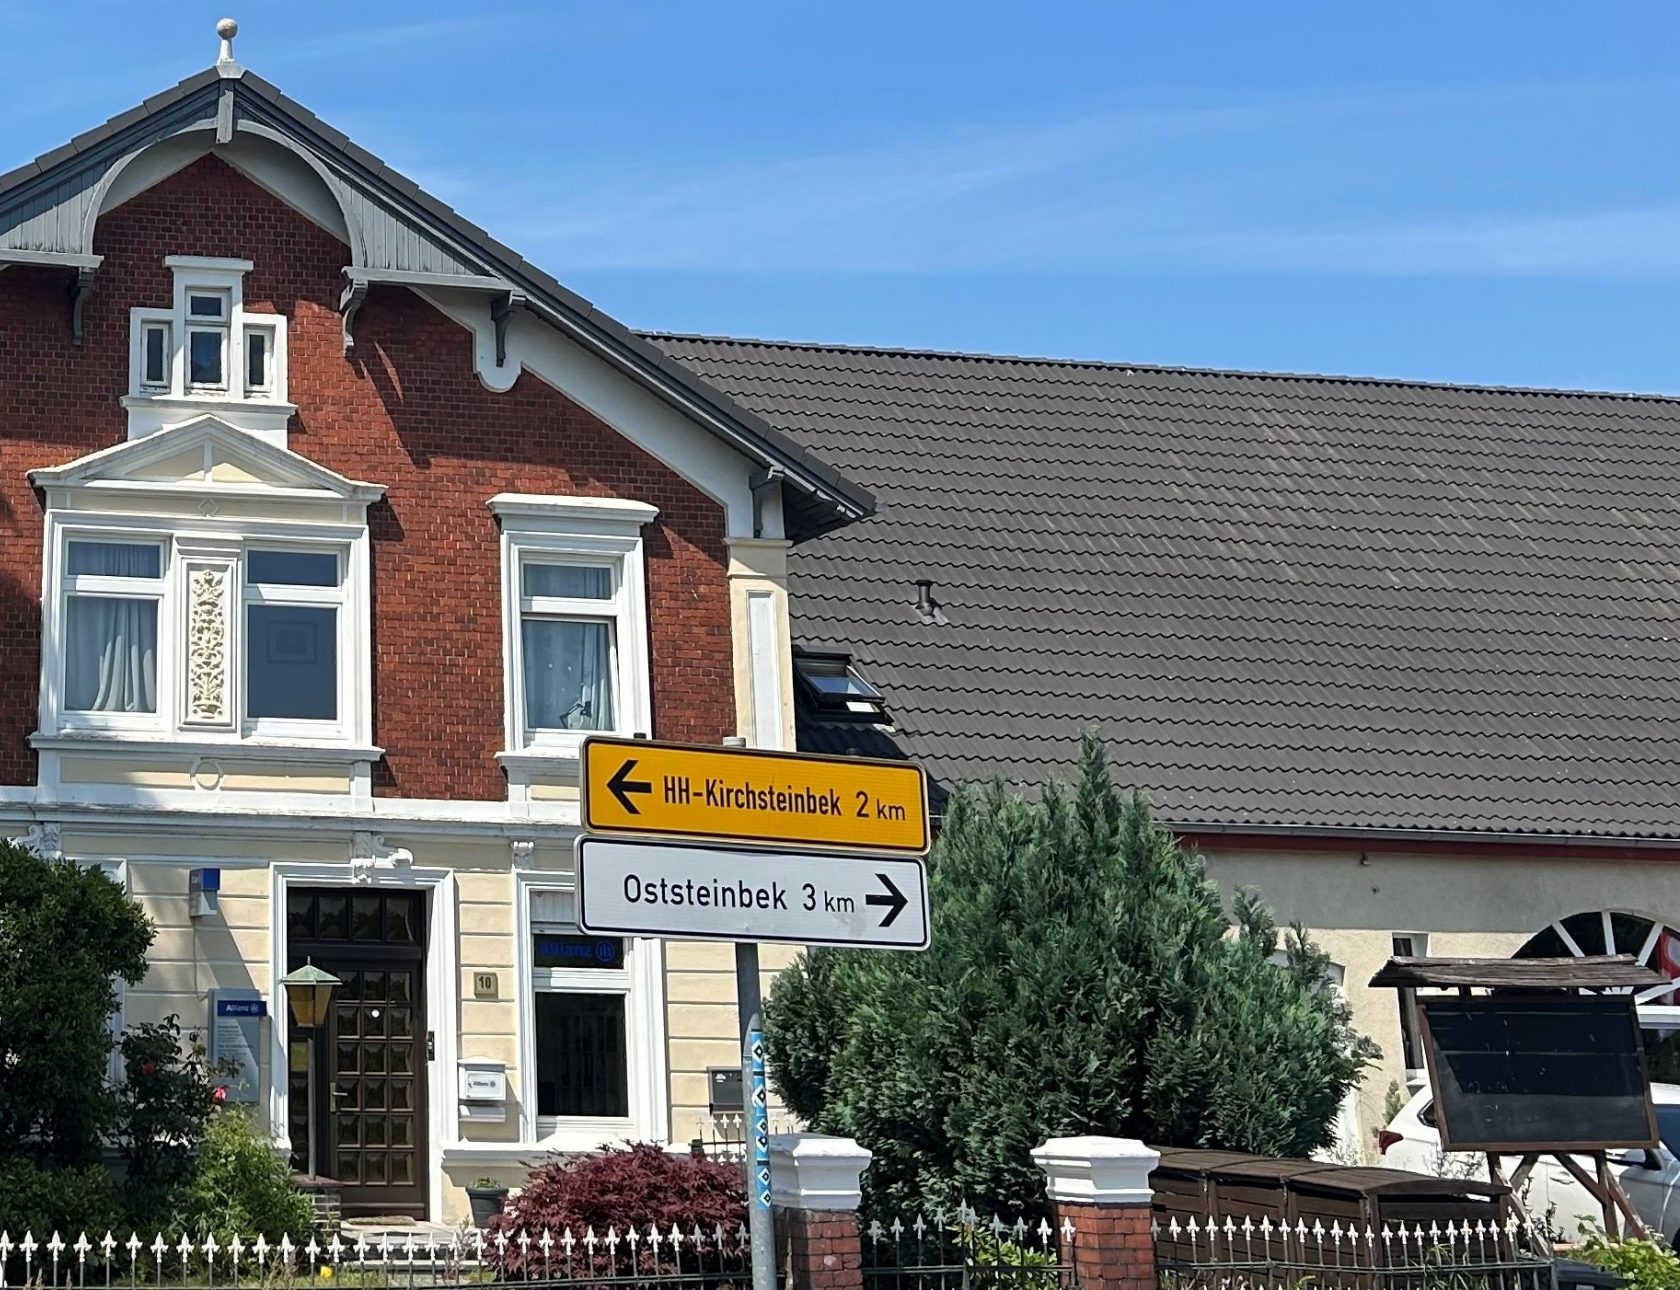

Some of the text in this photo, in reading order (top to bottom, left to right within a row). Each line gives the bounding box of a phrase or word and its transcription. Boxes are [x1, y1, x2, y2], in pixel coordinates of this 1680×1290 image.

[663, 775, 906, 821] HH-Kirchsteinbek 2 km
[623, 873, 855, 913] Oststeinbek 3 km
[478, 975, 492, 989] 10
